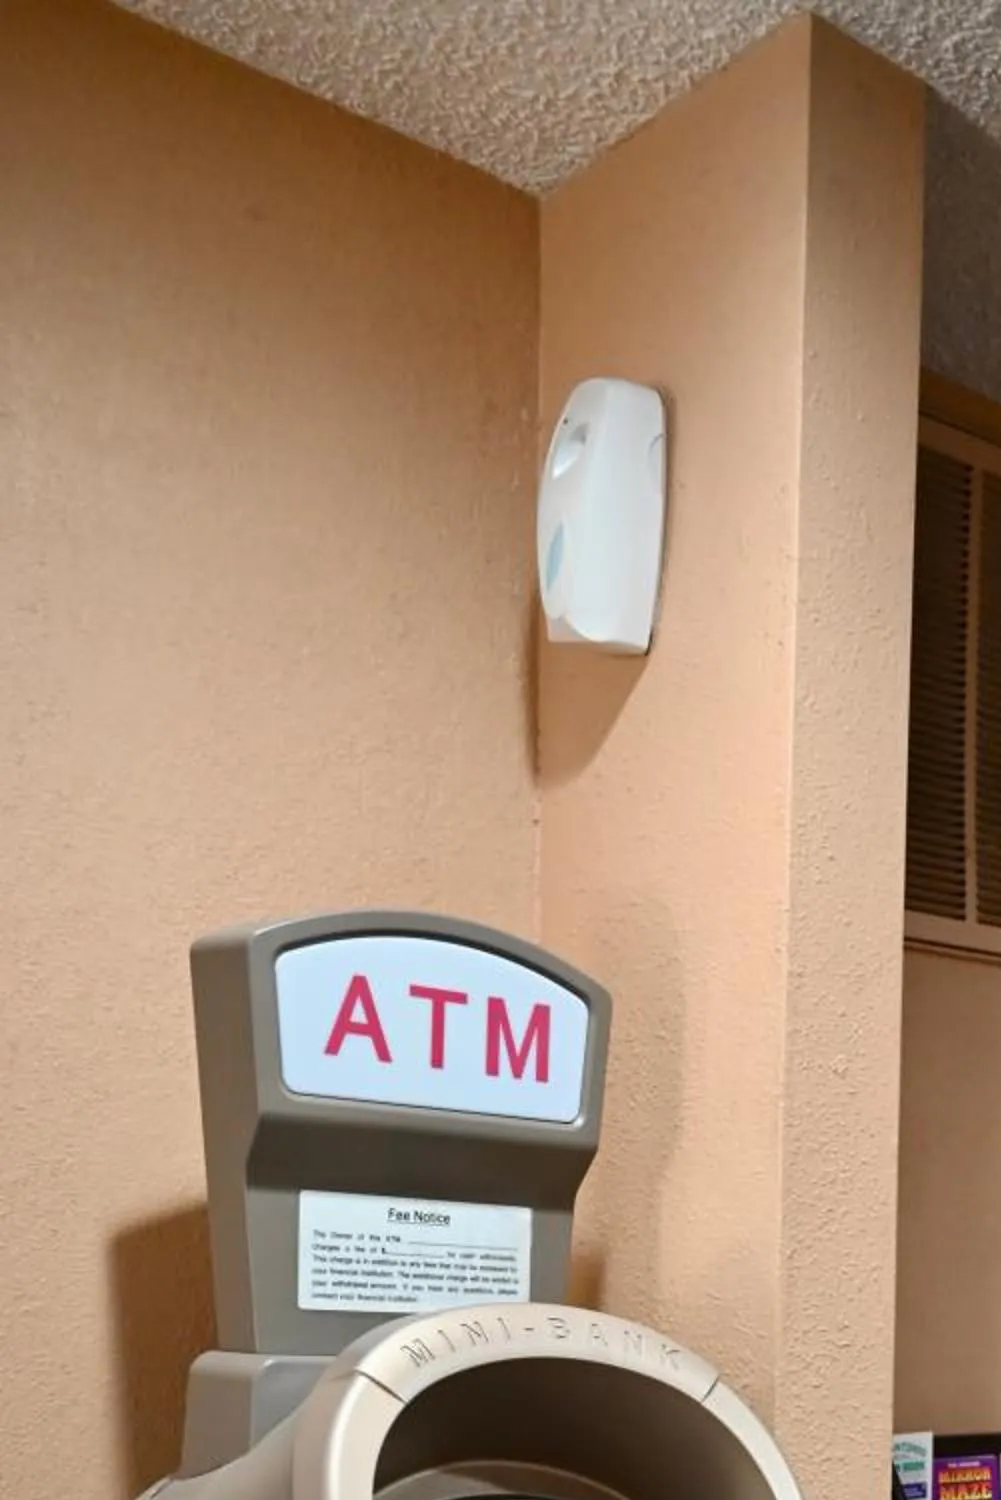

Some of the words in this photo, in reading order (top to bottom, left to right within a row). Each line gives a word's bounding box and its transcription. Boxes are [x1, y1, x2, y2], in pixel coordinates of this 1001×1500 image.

[324, 973, 551, 1083] ATM
[388, 1208, 411, 1221] Fee
[413, 1209, 451, 1224] Notice
